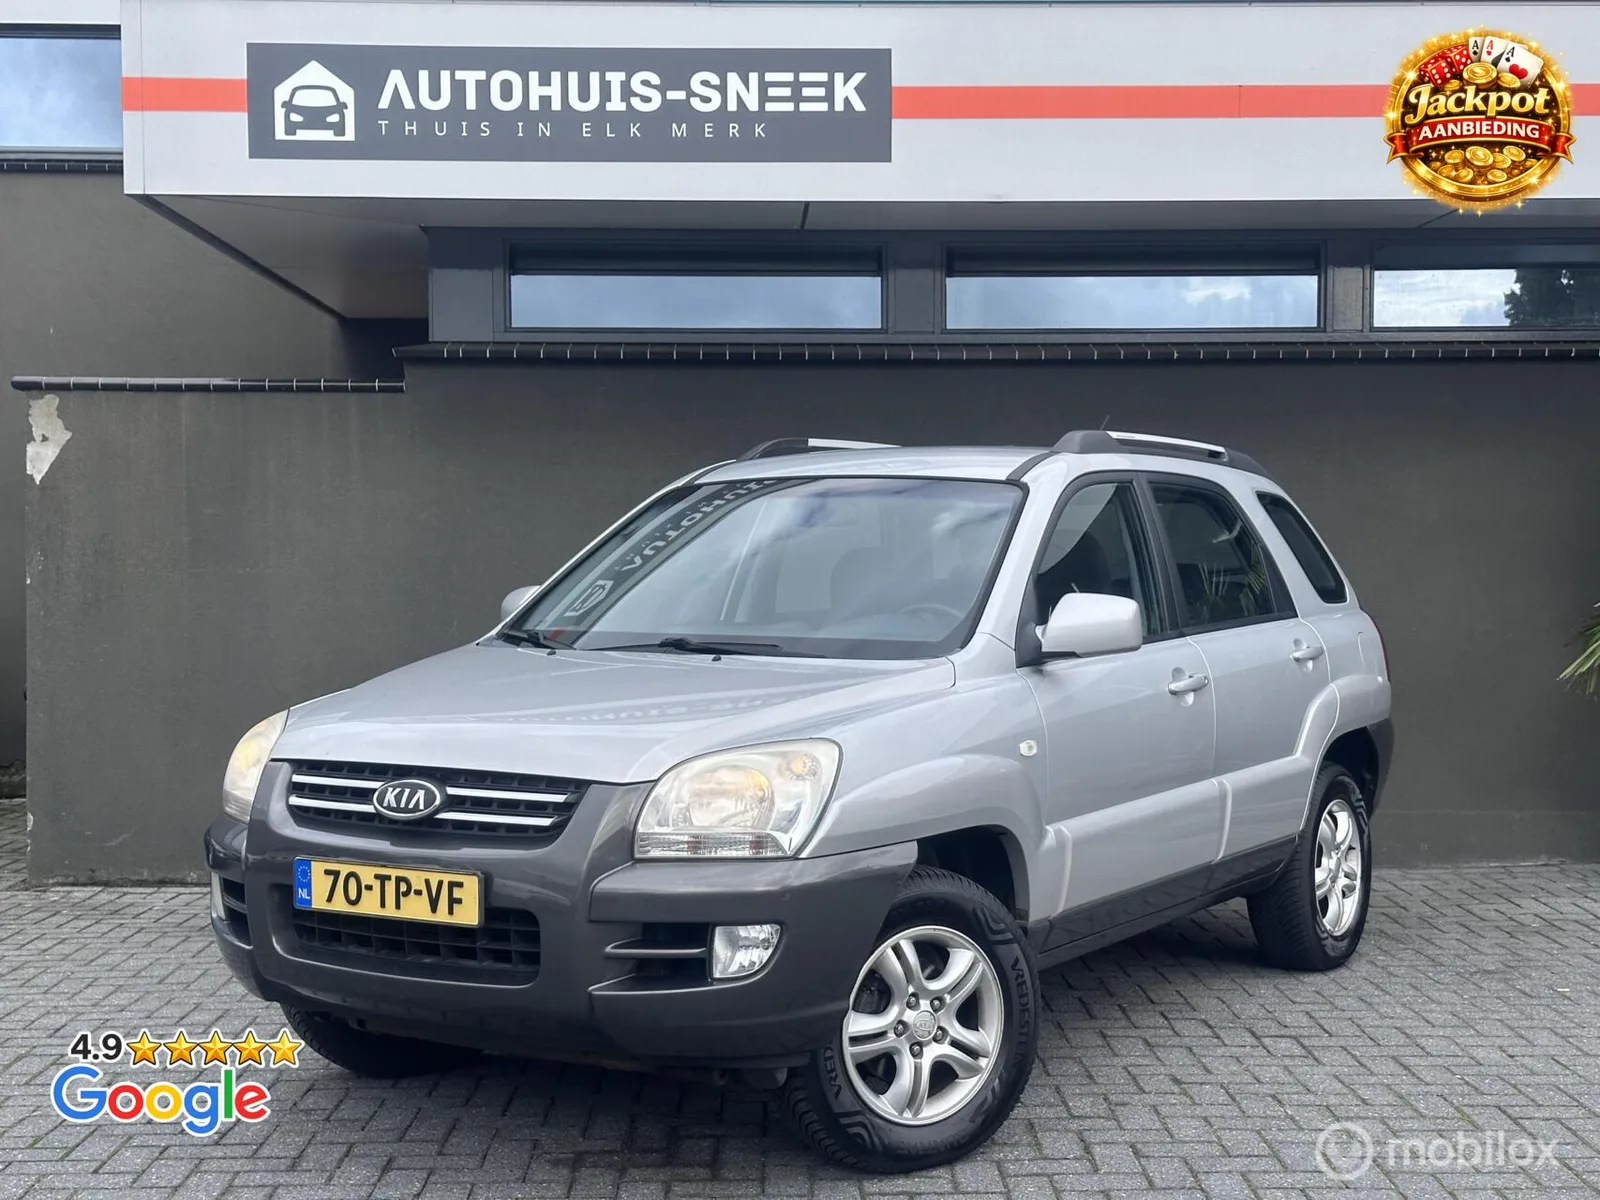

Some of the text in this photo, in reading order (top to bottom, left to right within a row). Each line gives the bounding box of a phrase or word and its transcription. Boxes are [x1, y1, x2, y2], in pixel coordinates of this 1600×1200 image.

[377, 69, 867, 113] AUTOHUIS-SNEEK
[377, 120, 766, 138] THUIS IN ELK MERK
[382, 786, 426, 810] KIA
[298, 887, 311, 900] NL
[323, 868, 464, 916] 70-TP-VF
